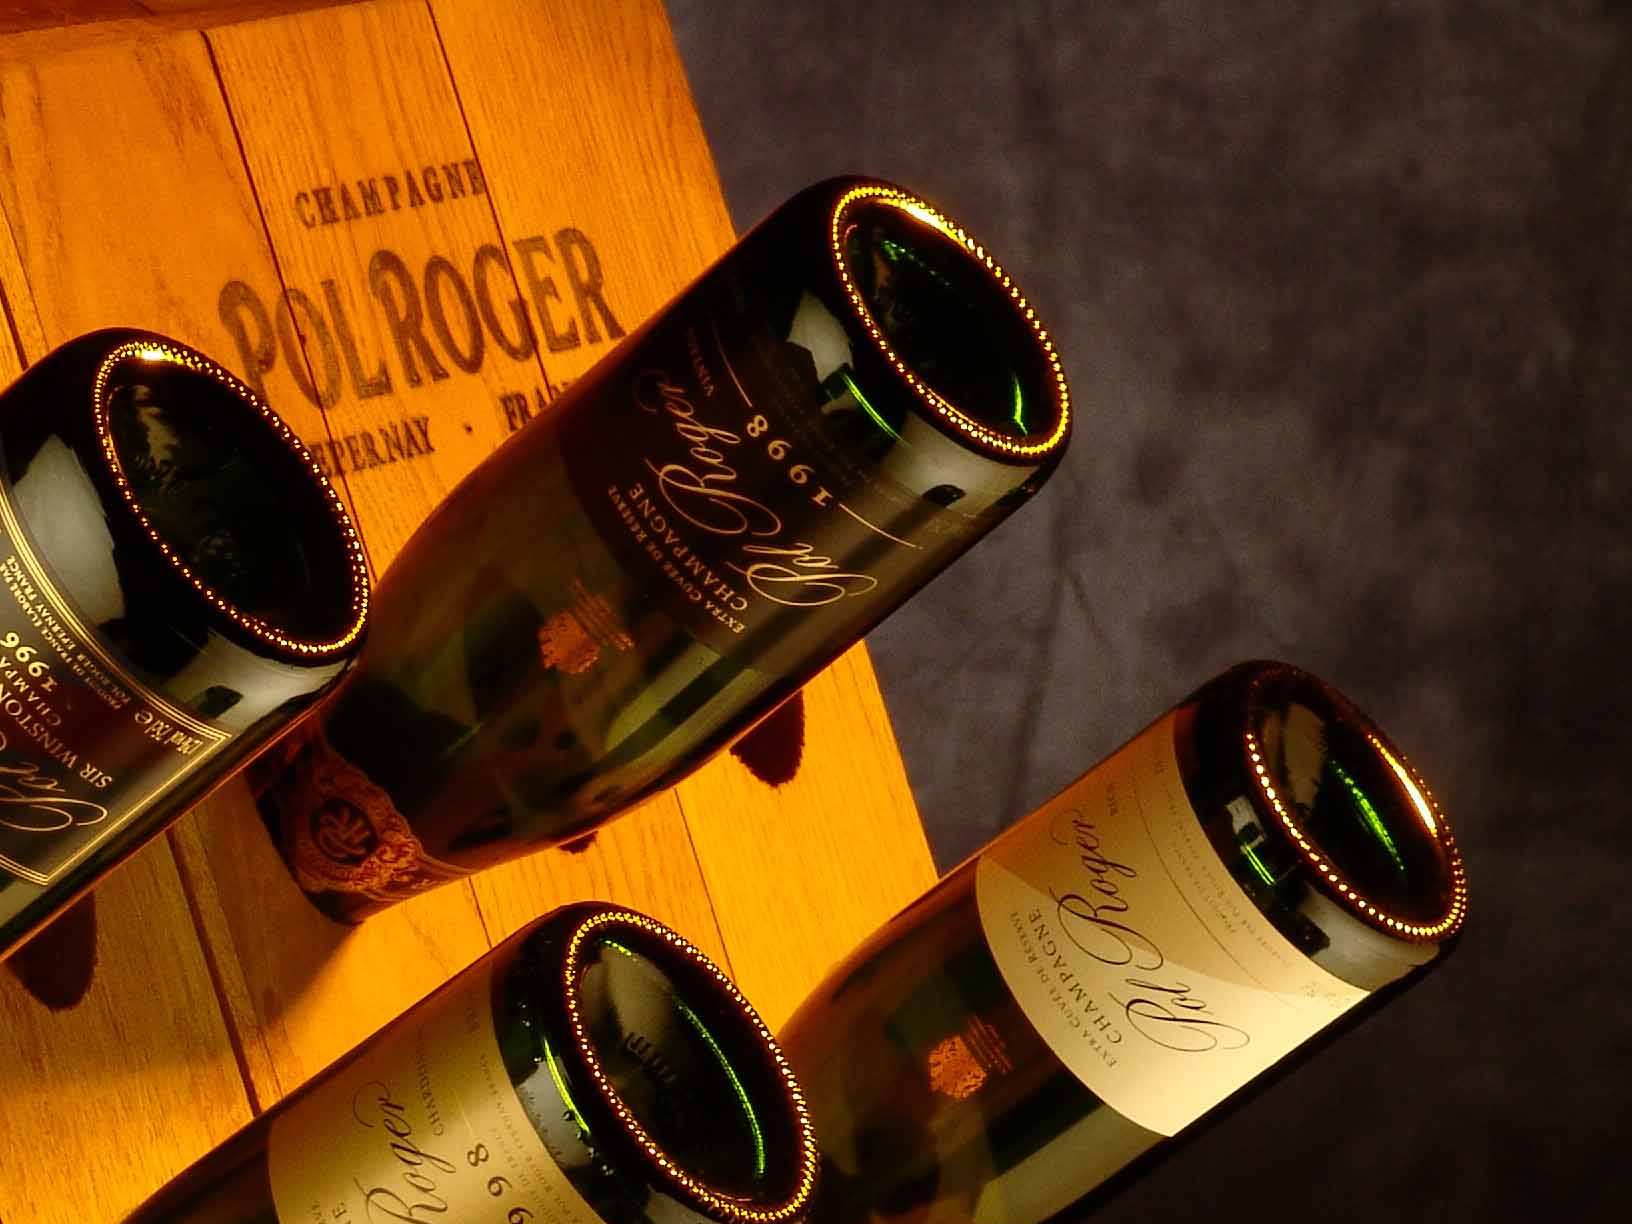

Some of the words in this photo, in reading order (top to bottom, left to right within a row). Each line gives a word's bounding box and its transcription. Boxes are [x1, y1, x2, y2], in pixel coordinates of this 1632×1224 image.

[295, 160, 487, 229] CHAMPAGNE
[218, 281, 393, 409] POL
[369, 227, 627, 389] ROGER
[307, 417, 435, 478] EPERNAY
[631, 366, 779, 535] Roger
[744, 411, 833, 506] 1998
[6, 554, 37, 600] FRANCE
[627, 481, 747, 612] CHAMPAGNE
[724, 539, 877, 610] Pol
[0, 629, 56, 693] 1996
[39, 625, 72, 663] FRANCE
[77, 762, 112, 788] SIR
[1047, 806, 1162, 969] Roger
[1027, 906, 1123, 1046] CHAMPAGNE
[1105, 977, 1250, 1051] Pol
